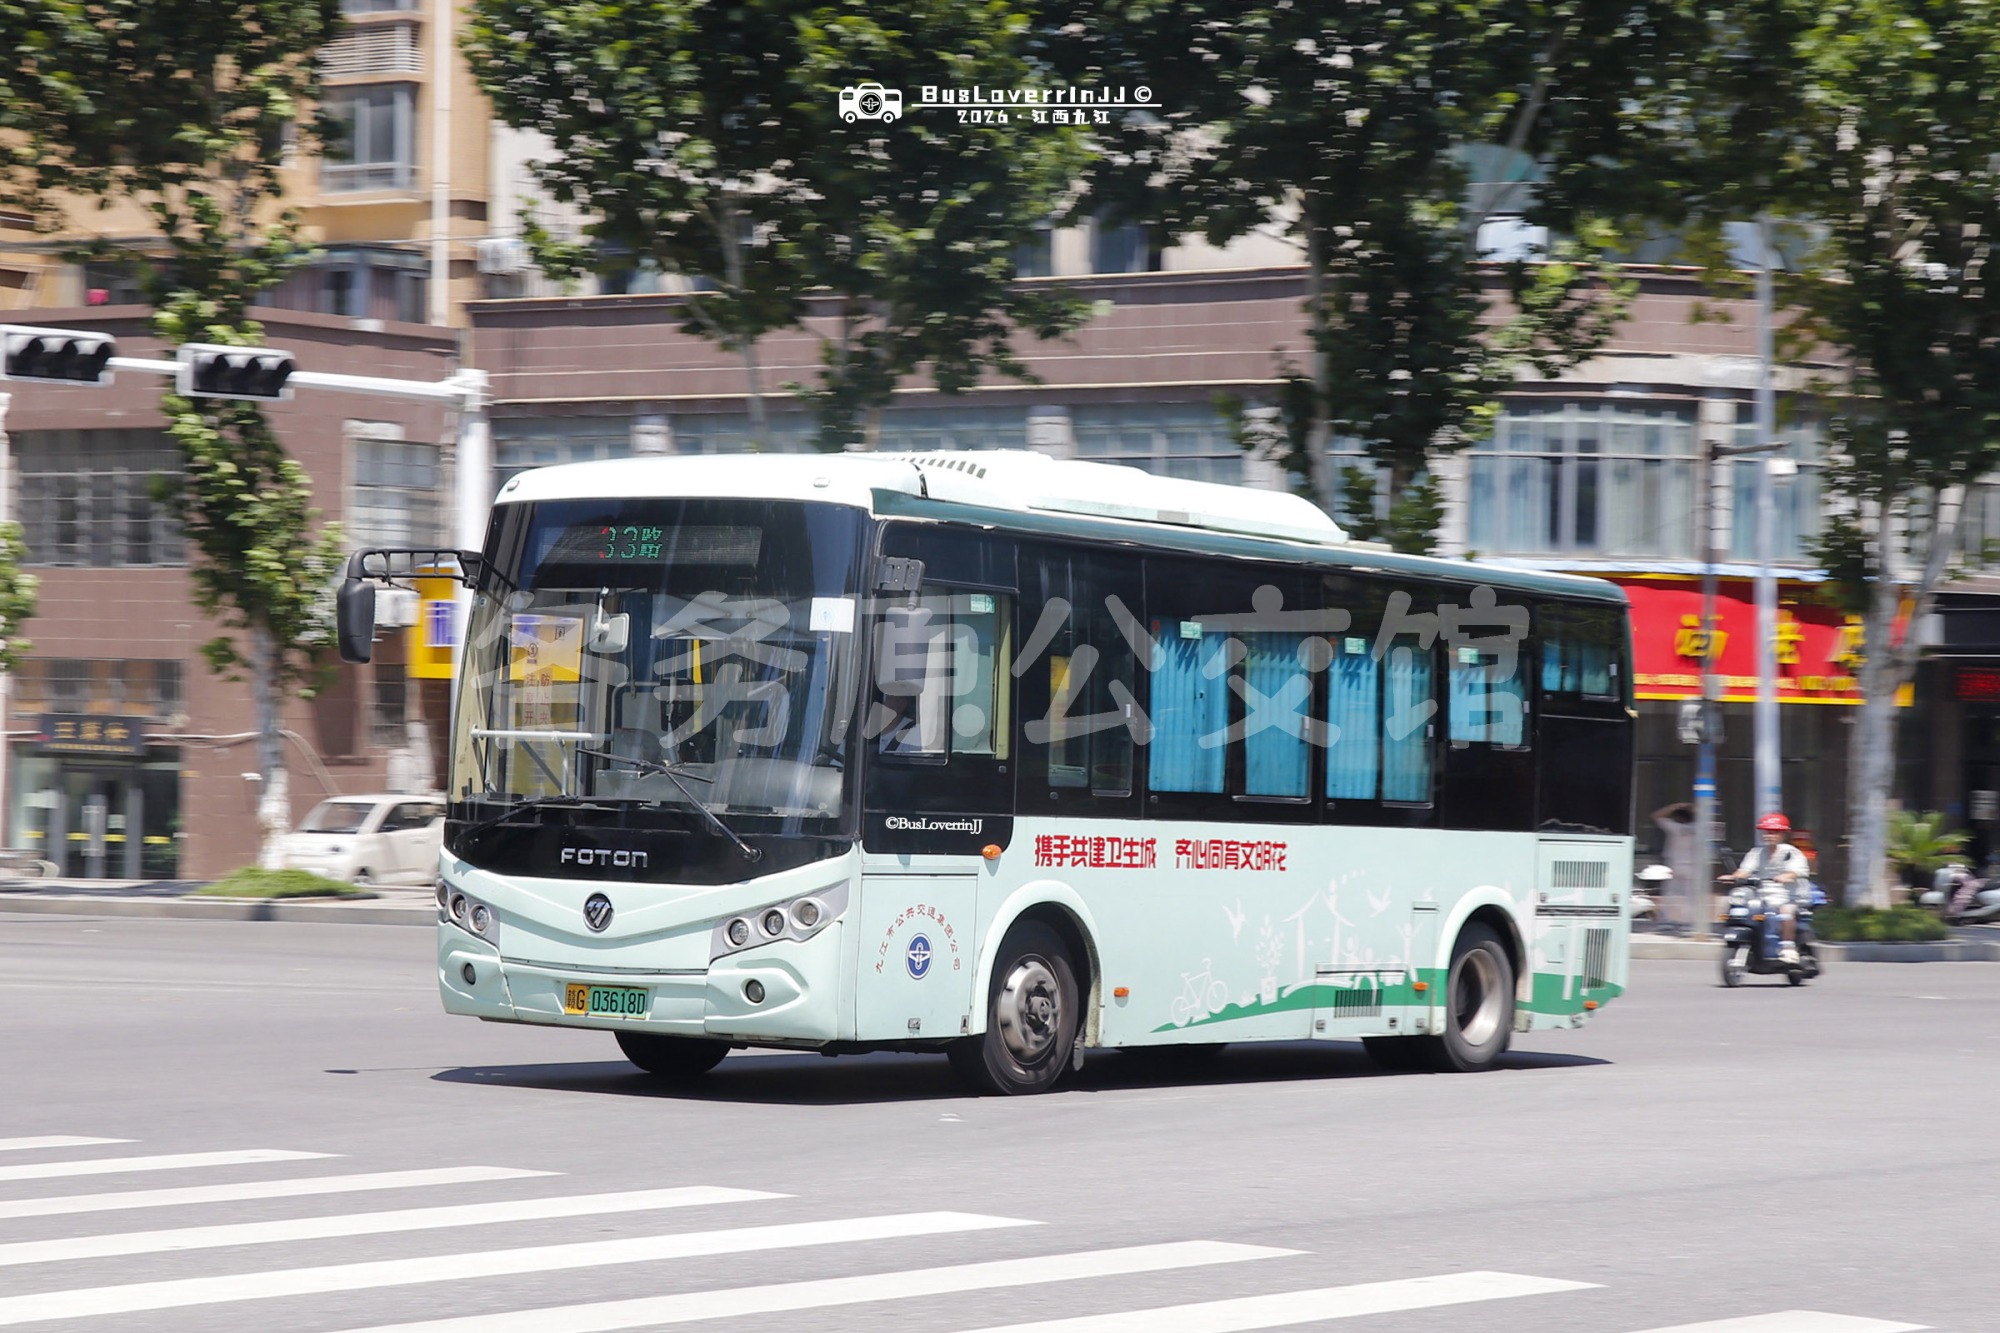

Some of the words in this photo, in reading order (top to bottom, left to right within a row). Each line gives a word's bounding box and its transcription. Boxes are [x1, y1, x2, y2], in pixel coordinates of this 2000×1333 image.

[599, 526, 663, 558] 33路
[561, 847, 648, 868] FOTON
[1035, 834, 1157, 868] 携手共建卫生城
[1175, 838, 1288, 871] 齐心同育文明花
[875, 903, 961, 974] 九江市公共交通集团公司
